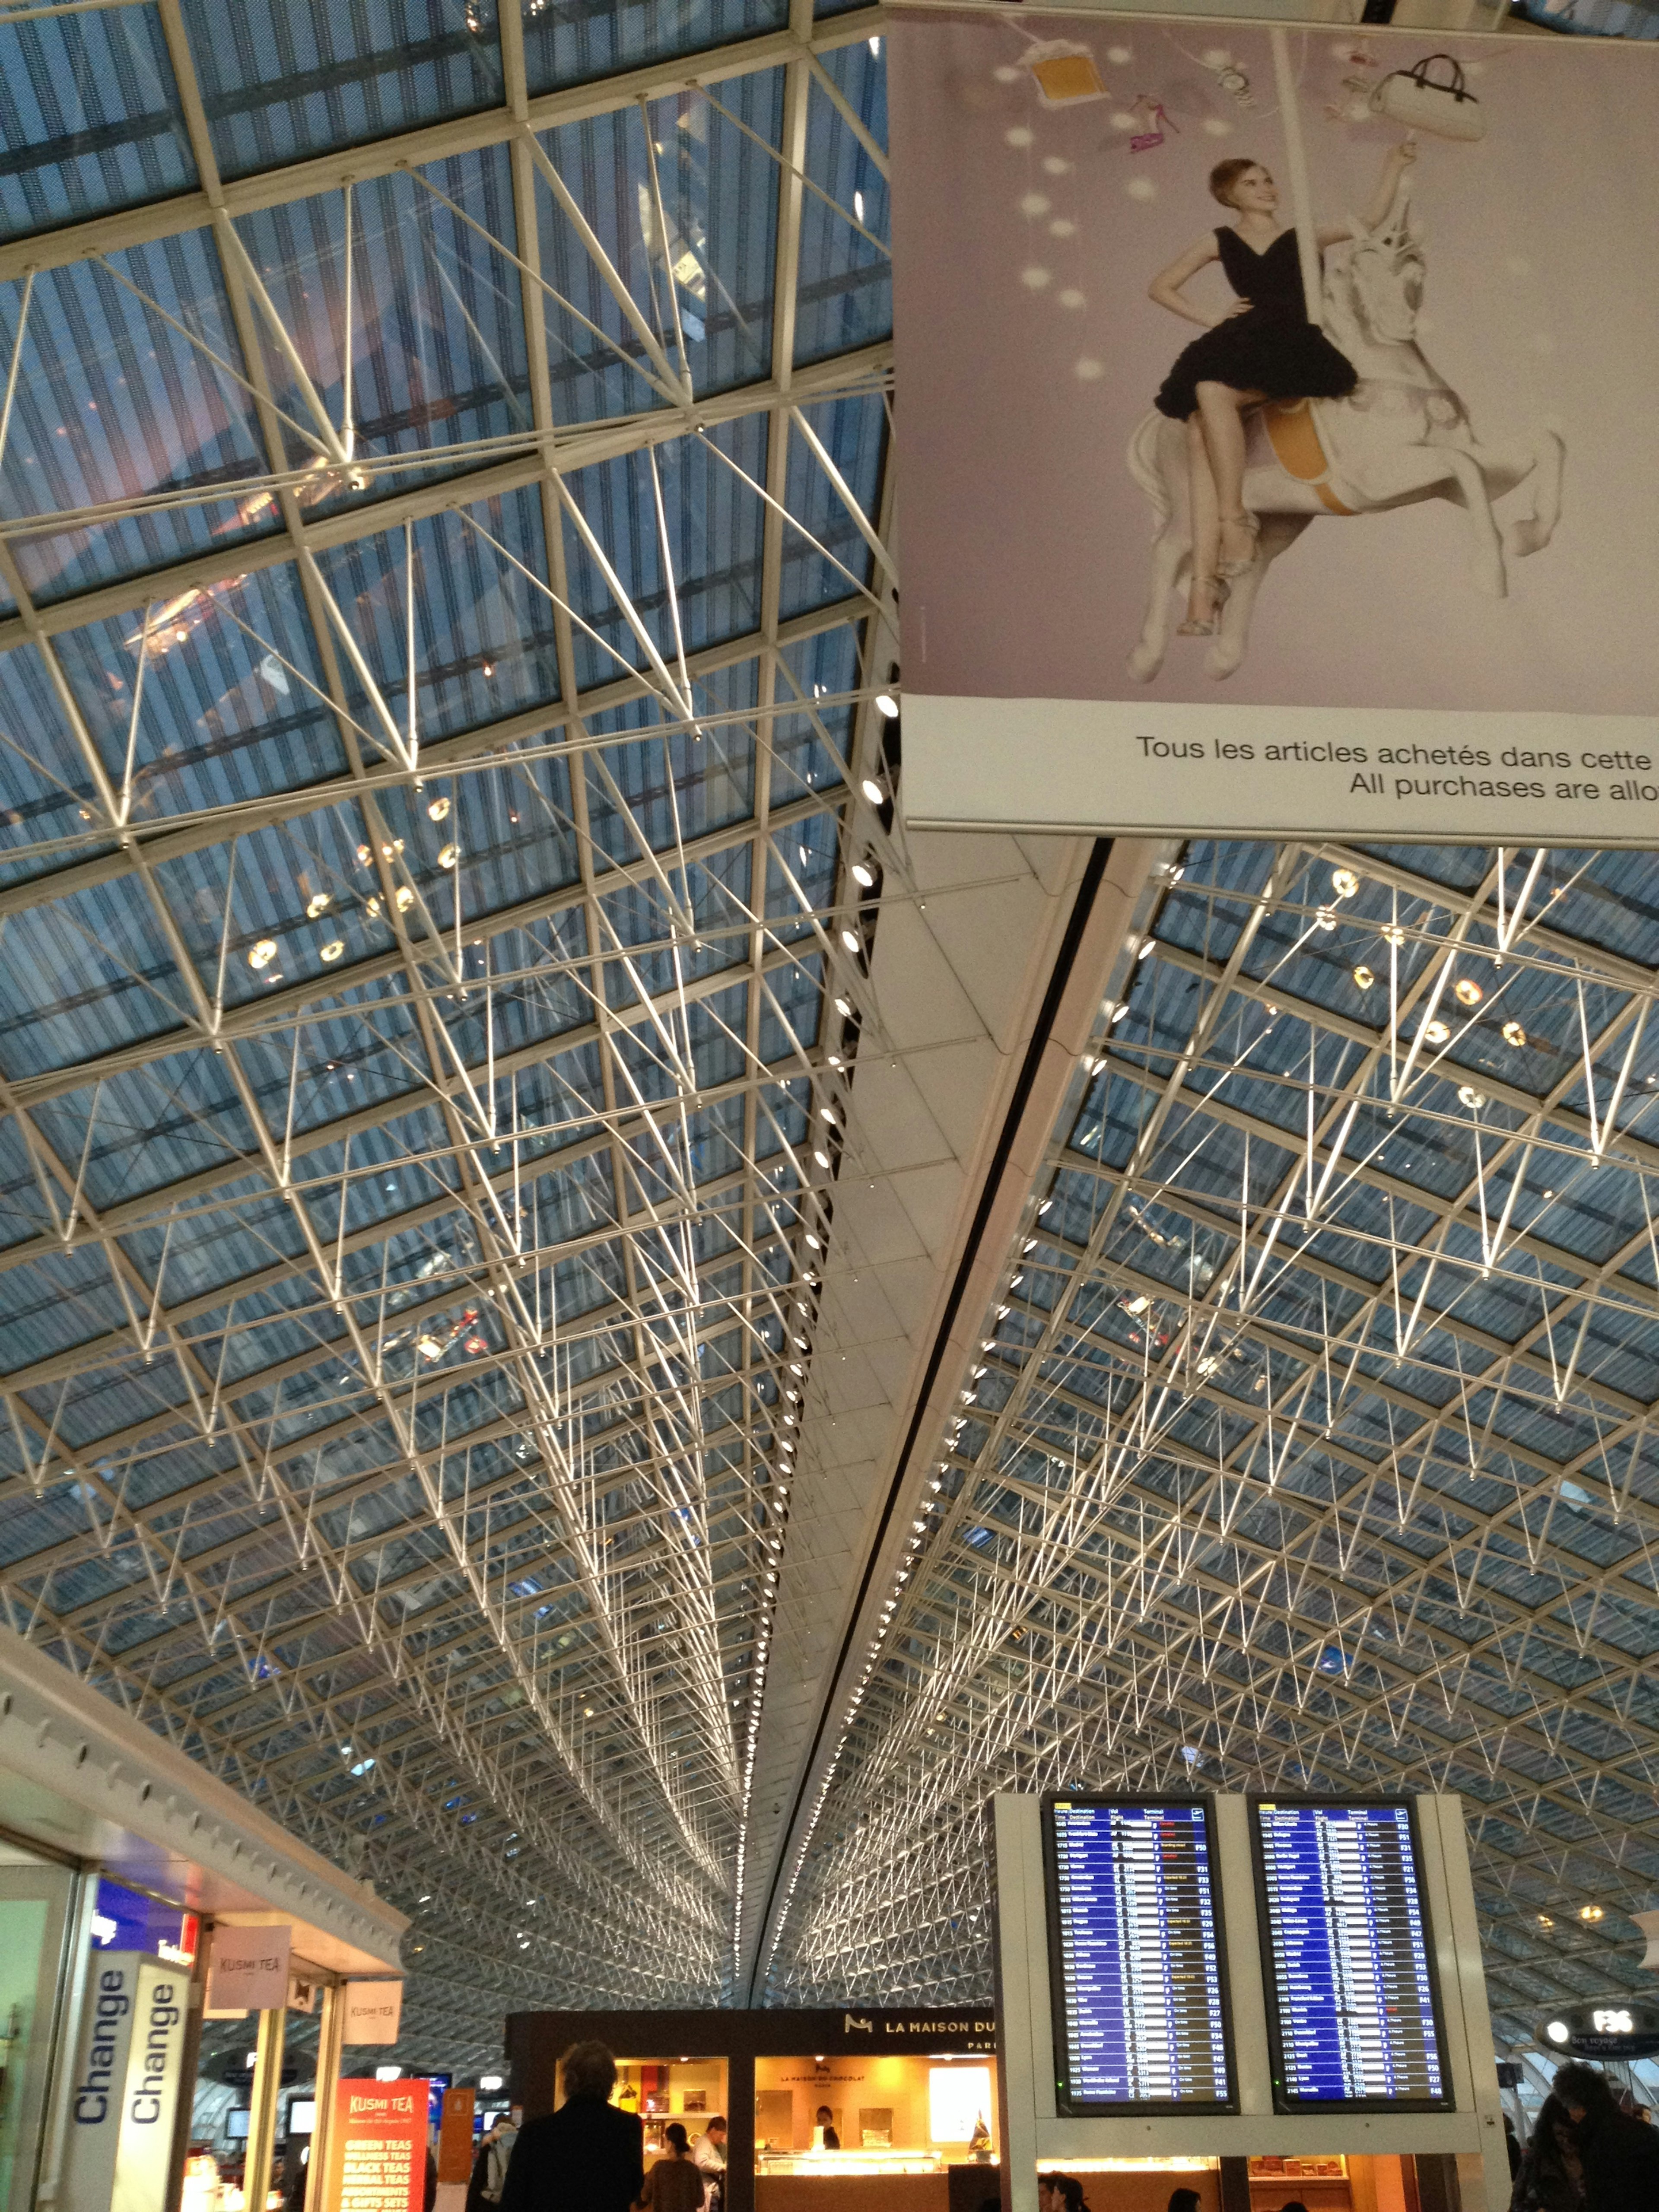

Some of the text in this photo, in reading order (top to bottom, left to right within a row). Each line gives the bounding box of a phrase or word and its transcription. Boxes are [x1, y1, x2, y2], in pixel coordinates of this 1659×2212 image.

[1136, 736, 1652, 770] Tous les articles achetés dans cette
[1350, 773, 1659, 801] All purchases are allo
[220, 1958, 279, 1973] KUSMI TEA
[350, 2006, 394, 2017] KUSMI TEA
[886, 2022, 996, 2033] LA MAISON DU
[1571, 2036, 1618, 2046] Bon voyage
[74, 1970, 129, 2124] Change
[130, 1984, 179, 2124] Change
[350, 2095, 414, 2114] KUSMI TEA
[345, 2140, 412, 2150] GREEN TEAS
[391, 2152, 411, 2160] TEAS
[343, 2162, 410, 2173] BLACK TEAS
[385, 2174, 410, 2184] TEAS
[384, 2197, 408, 2208] SETS
